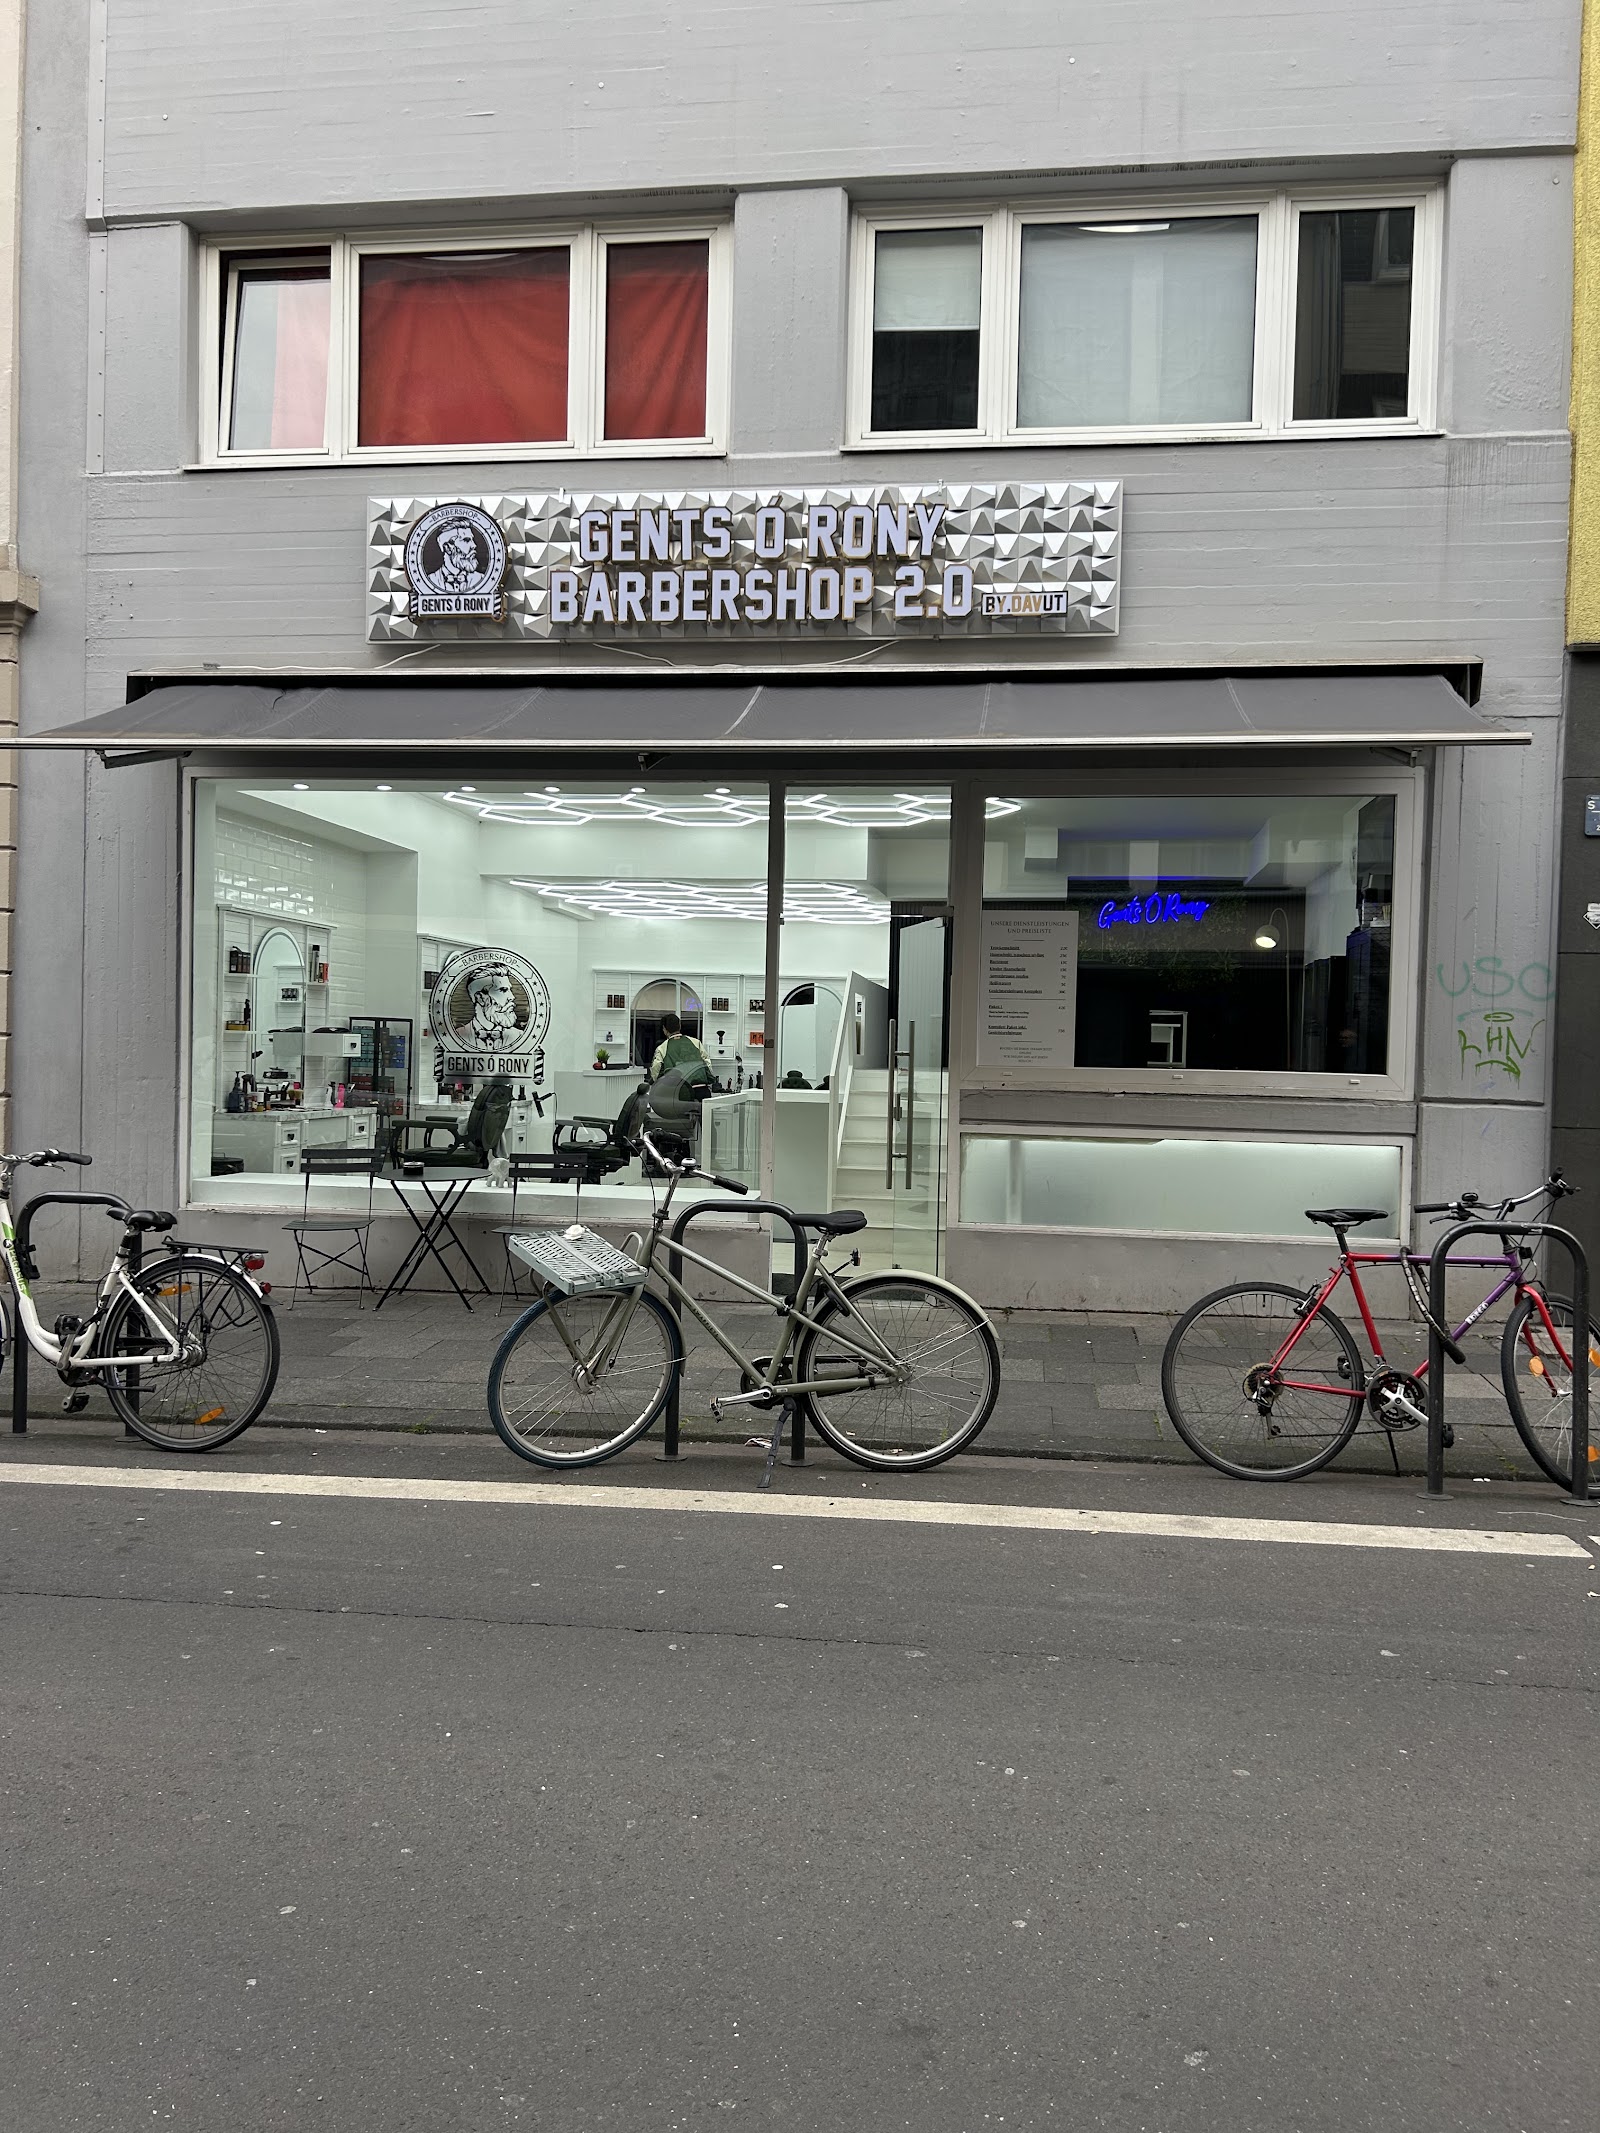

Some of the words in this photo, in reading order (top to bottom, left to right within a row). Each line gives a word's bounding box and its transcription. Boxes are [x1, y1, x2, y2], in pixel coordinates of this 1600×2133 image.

[432, 508, 479, 521] BARBERSHOP
[579, 505, 732, 563] GENTS
[755, 495, 786, 559] Ó
[807, 502, 947, 559] RONY
[551, 566, 874, 622] BARBERSHOP
[894, 564, 974, 619] 2.0
[422, 599, 452, 612] GENTS
[455, 596, 461, 611] Ó
[463, 598, 491, 611] RONY
[985, 593, 1064, 613] BY.DAVUT
[462, 953, 518, 966] BARBERSHOP
[447, 1056, 485, 1072] GENTS
[487, 1055, 496, 1072] Ó
[498, 1057, 530, 1073] RONY
